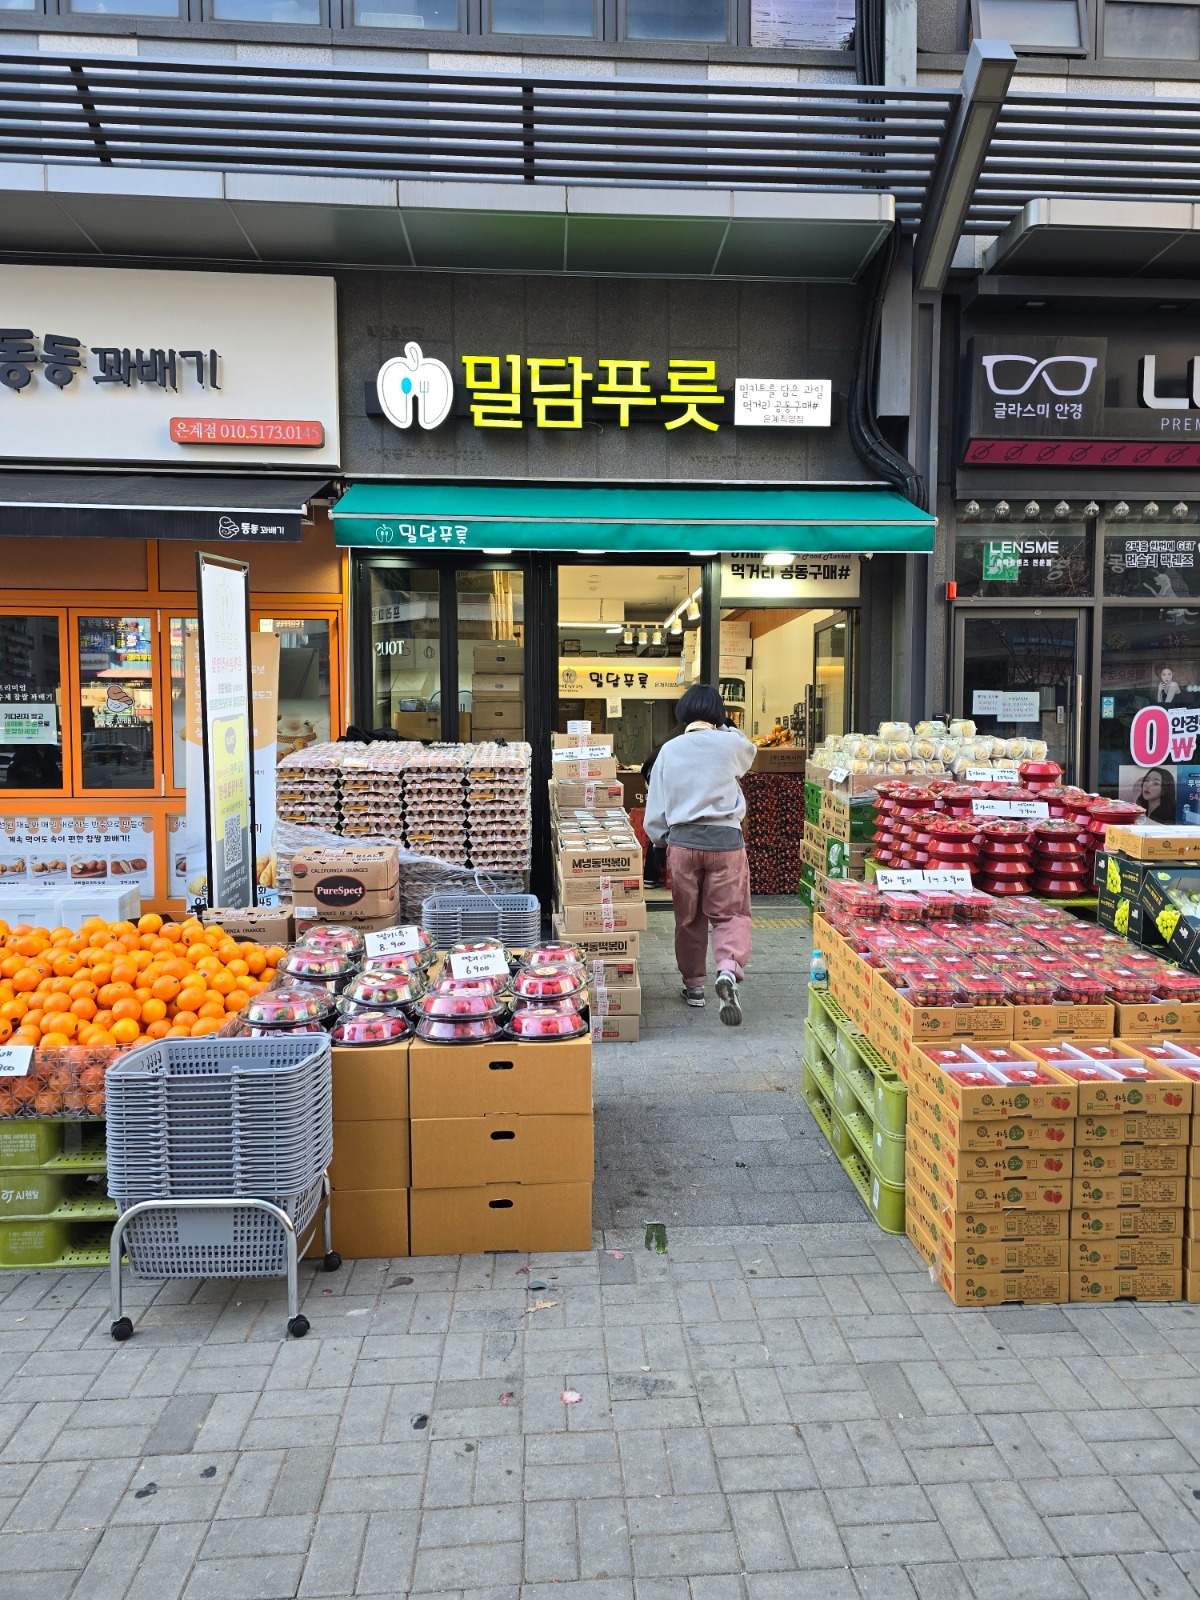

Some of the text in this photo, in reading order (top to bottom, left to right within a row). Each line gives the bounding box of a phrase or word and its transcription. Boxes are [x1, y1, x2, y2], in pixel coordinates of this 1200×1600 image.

[461, 354, 725, 432] 밀담푸릇
[740, 384, 823, 399] 밀키트를 담은 과일
[743, 400, 819, 413] 먹거리 공동구매#
[993, 402, 1082, 420] 글라스미 안경
[175, 421, 319, 440] 은계점 010.5173.0145
[399, 524, 468, 545] 밀담푸릇
[989, 541, 1059, 554] LENSME
[1150, 540, 1175, 552] 한번에
[1177, 540, 1196, 551] GET
[1125, 553, 1194, 568] 먼슬리 팩렌즈
[731, 563, 851, 580] 먹거리 공동구매#
[589, 672, 649, 689] 밀담푸릇
[1171, 714, 1200, 734] 안경
[1132, 707, 1170, 766] 0
[26, 834, 48, 843] 먹어도
[50, 834, 65, 843] 속이
[68, 834, 84, 843] 편한
[86, 834, 102, 843] 찹쌀
[572, 857, 631, 869] M냉동떡볶이
[316, 886, 364, 897] PureSpect
[466, 965, 490, 975] 6900
